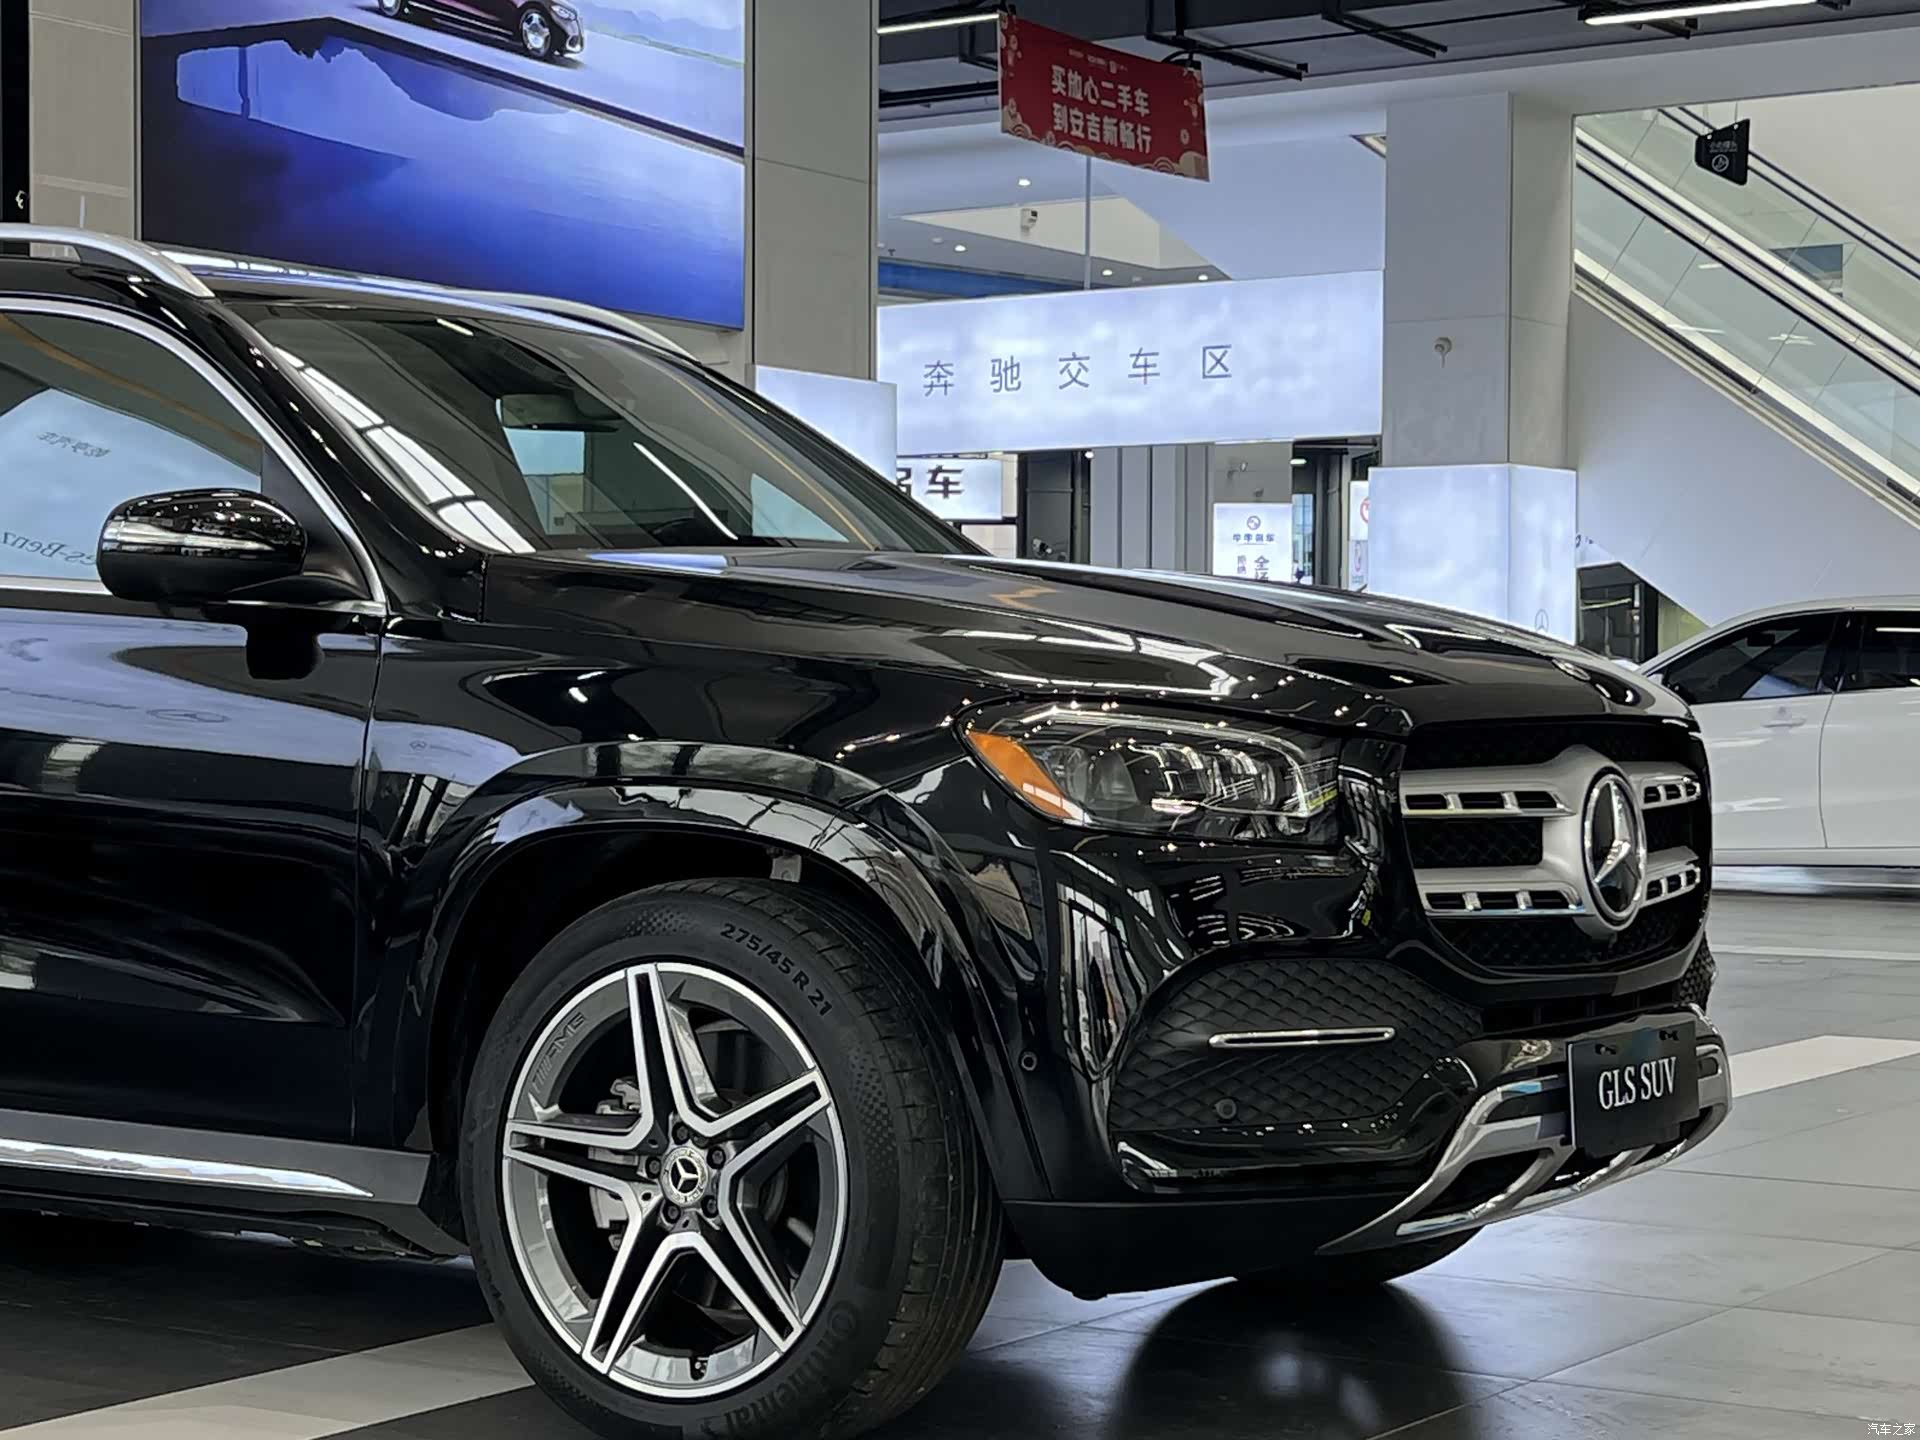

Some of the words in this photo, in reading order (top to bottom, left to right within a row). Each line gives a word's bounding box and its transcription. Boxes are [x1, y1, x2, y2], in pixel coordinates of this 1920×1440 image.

[1051, 64, 1150, 117] 买放心二手车
[1052, 102, 1152, 154] 到安吉新畅行
[923, 344, 1233, 397] 奔驰交车区
[720, 922, 796, 975] 275/45
[792, 970, 810, 992] R
[807, 987, 833, 1017] 21
[1598, 1068, 1637, 1111] GLS
[1640, 1056, 1677, 1100] SUV
